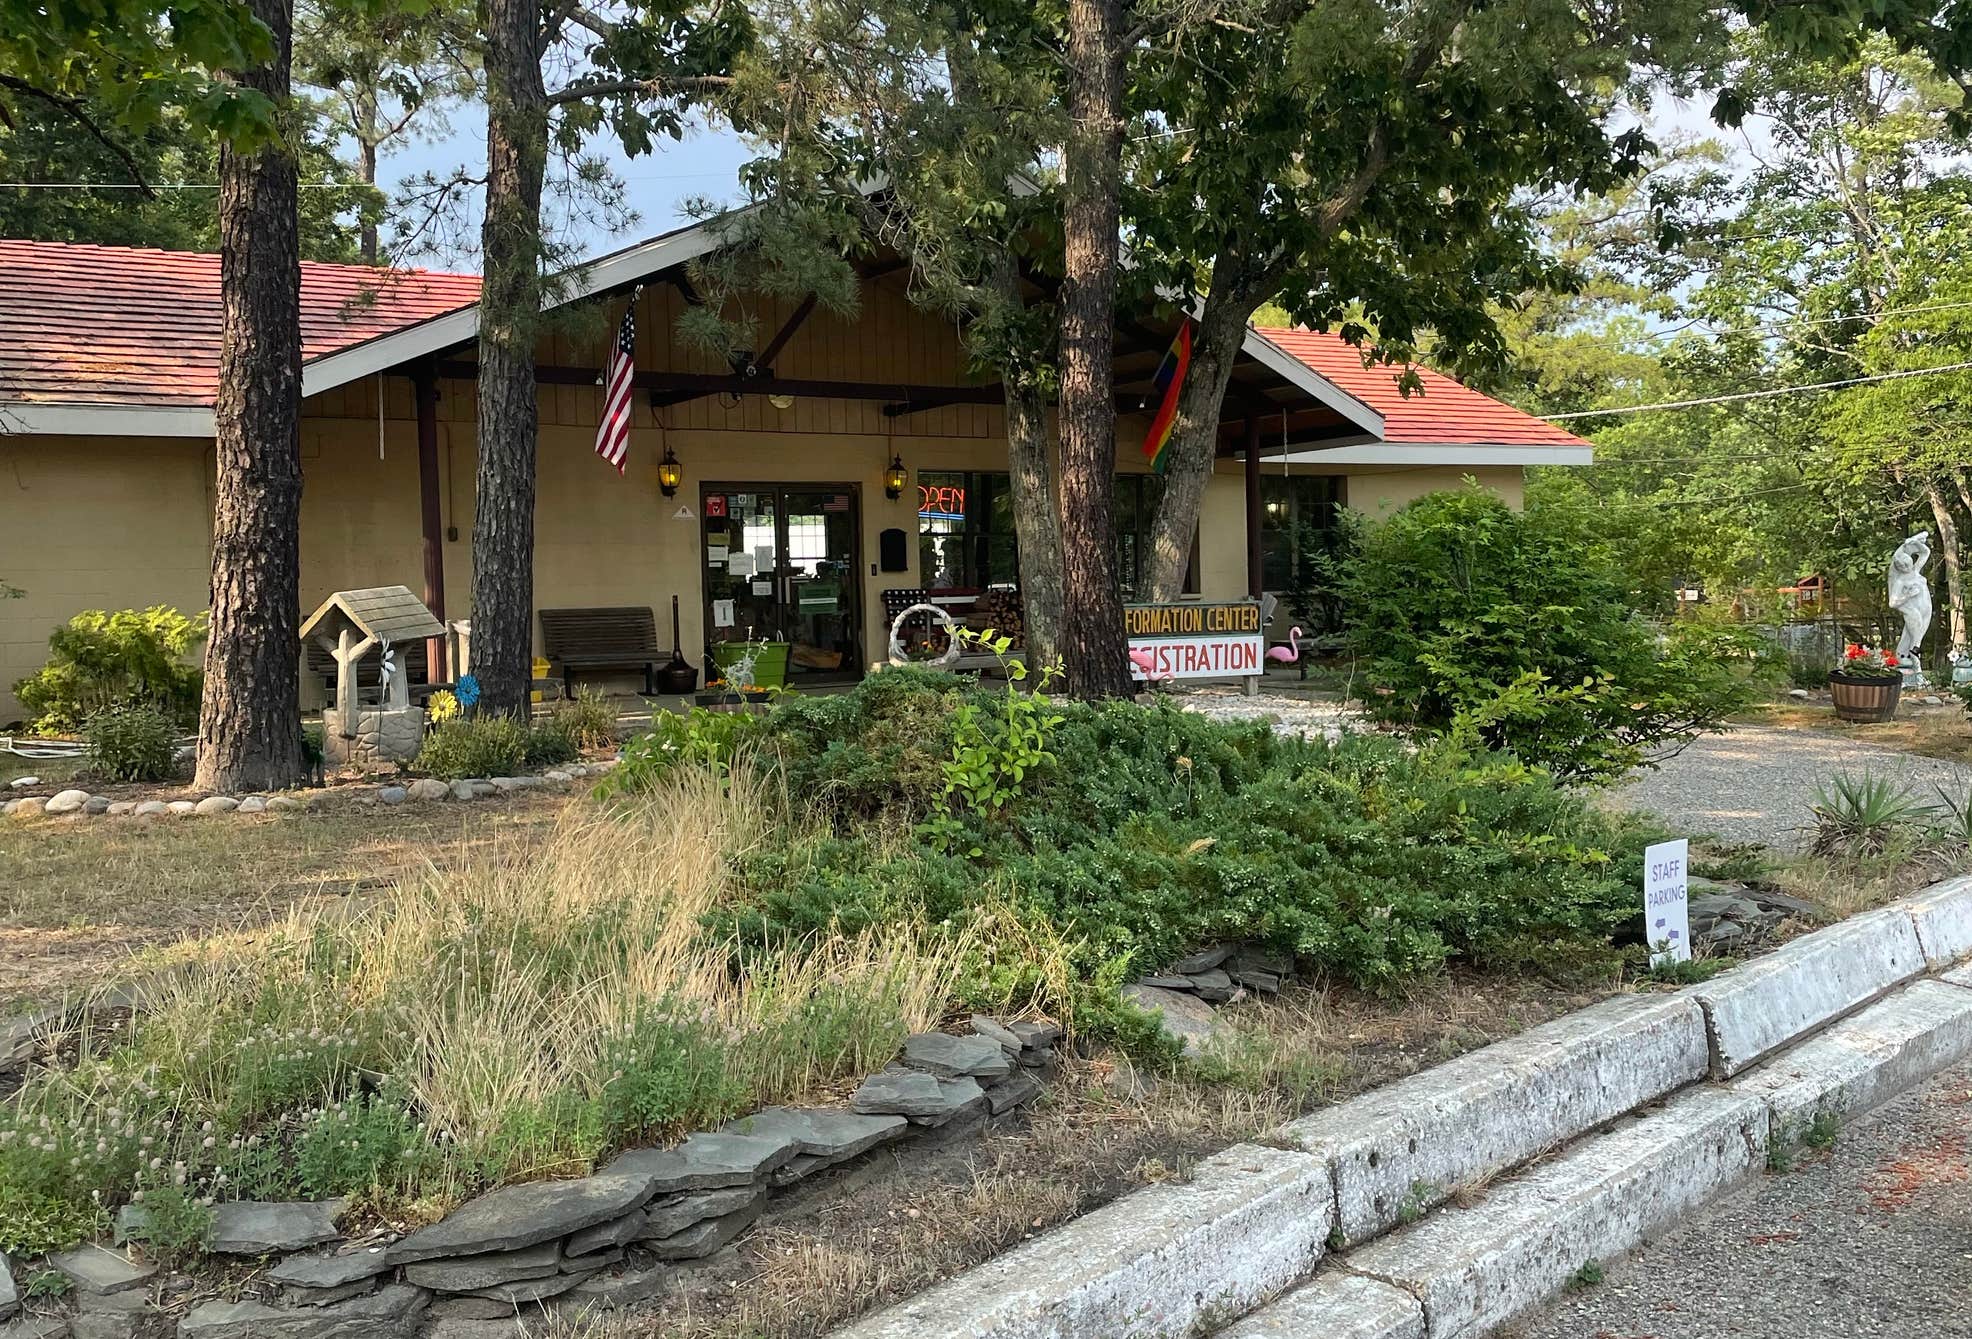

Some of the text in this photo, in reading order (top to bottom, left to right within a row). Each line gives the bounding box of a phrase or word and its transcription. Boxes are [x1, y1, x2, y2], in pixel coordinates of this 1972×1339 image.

[1125, 606, 1259, 634] FORMATION CENTER
[1128, 642, 1257, 674] ISTRATION
[1652, 860, 1680, 882] STAFF
[1648, 884, 1686, 909] PARKING
